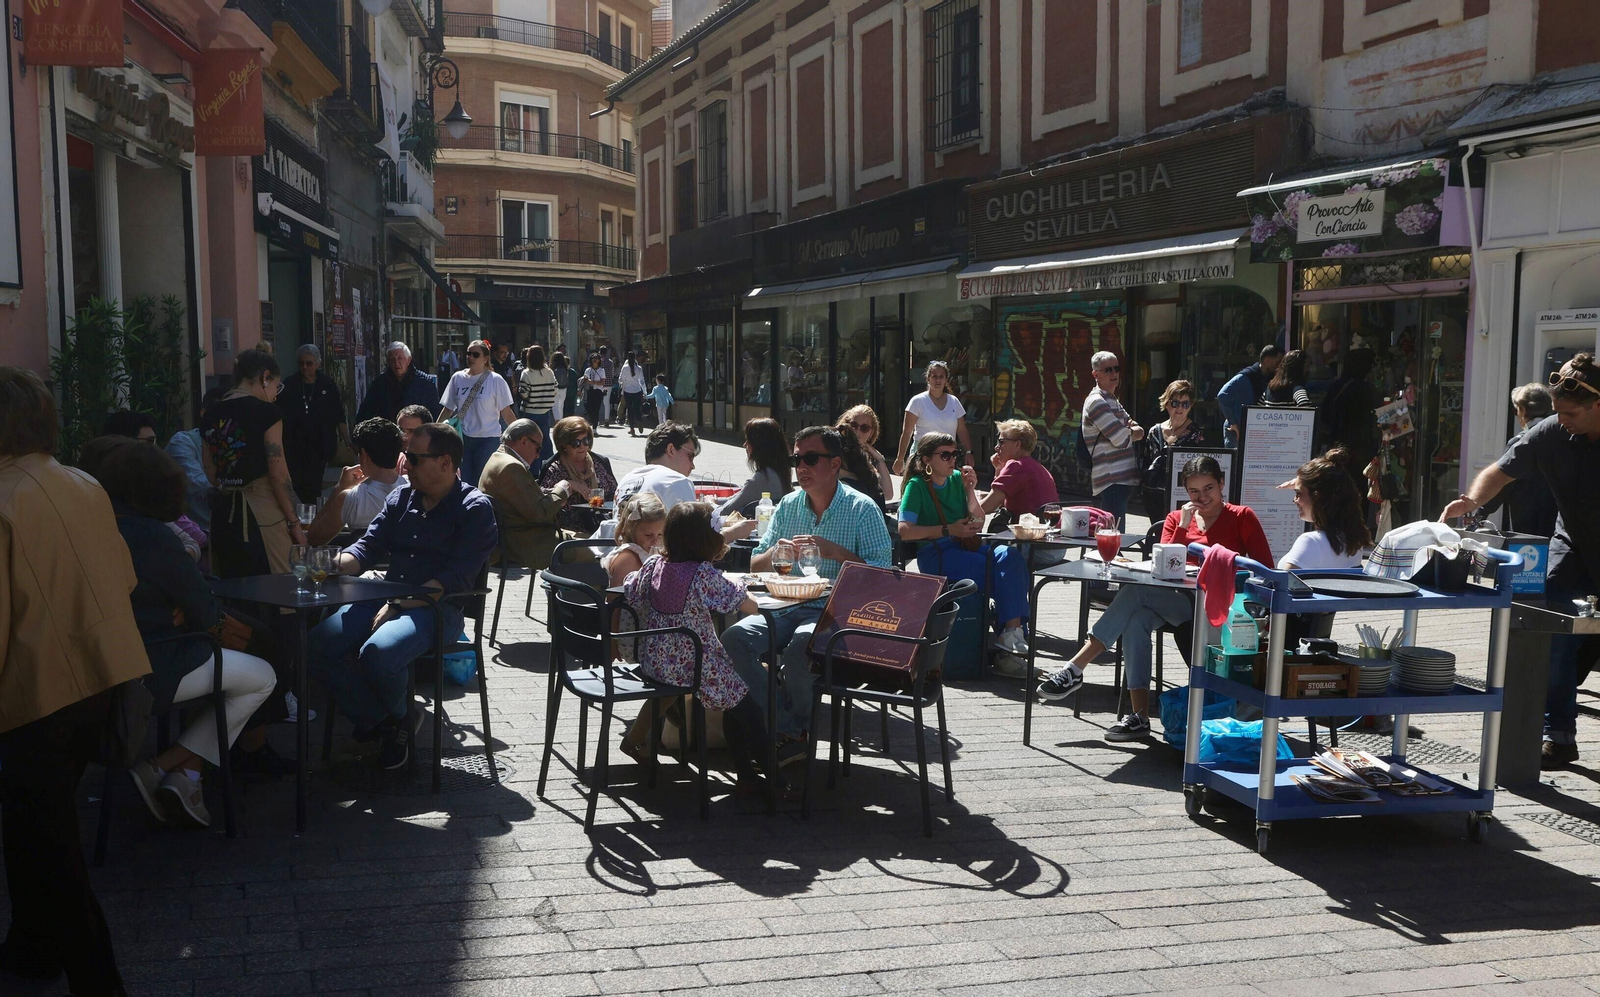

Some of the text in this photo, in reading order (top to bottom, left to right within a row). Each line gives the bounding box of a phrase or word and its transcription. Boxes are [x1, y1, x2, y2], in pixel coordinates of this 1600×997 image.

[197, 58, 255, 122] Virginia Reyes
[263, 145, 276, 176] LA
[985, 162, 1173, 222] CUCHILLERIA
[1307, 197, 1375, 221] ProvocArte
[1022, 207, 1120, 243] SEVILLA
[1315, 218, 1368, 237] ConCiencia
[812, 239, 850, 263] Serrano
[850, 225, 900, 258] Navarro
[969, 269, 1085, 297] CUCHILLERIA SEVILLA
[1084, 265, 1229, 289] WWW.CUCHILLERIASEVILLA.COM
[506, 288, 556, 299] LUISA
[456, 386, 485, 396] 171
[1263, 413, 1302, 421] CASA TONI
[869, 621, 896, 630] Ancha
[876, 615, 898, 624] Crespo
